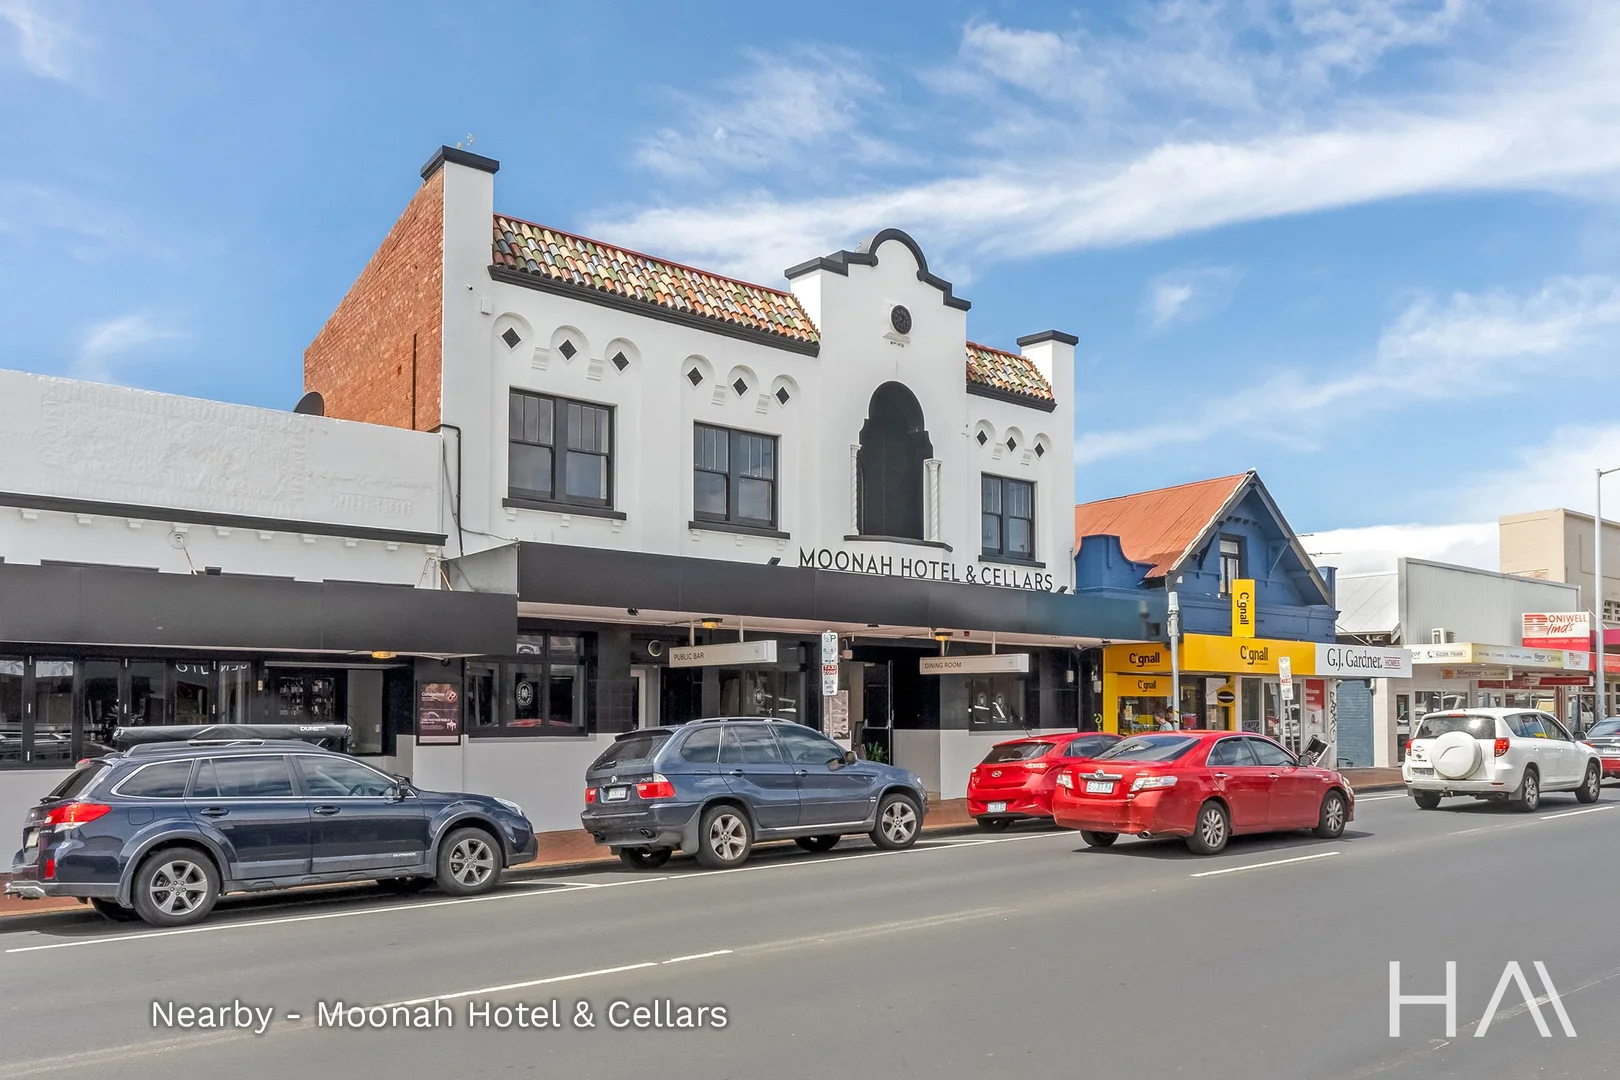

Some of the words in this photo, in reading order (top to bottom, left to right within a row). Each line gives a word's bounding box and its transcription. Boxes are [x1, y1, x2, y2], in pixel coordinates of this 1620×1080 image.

[800, 547, 892, 575] MOONAH
[901, 557, 960, 582] HOTEL
[966, 564, 977, 584] &
[981, 567, 1053, 590] CELLARS
[693, 651, 705, 660] BAR
[1327, 647, 1344, 671] G.J.
[1384, 659, 1401, 667] HOMES
